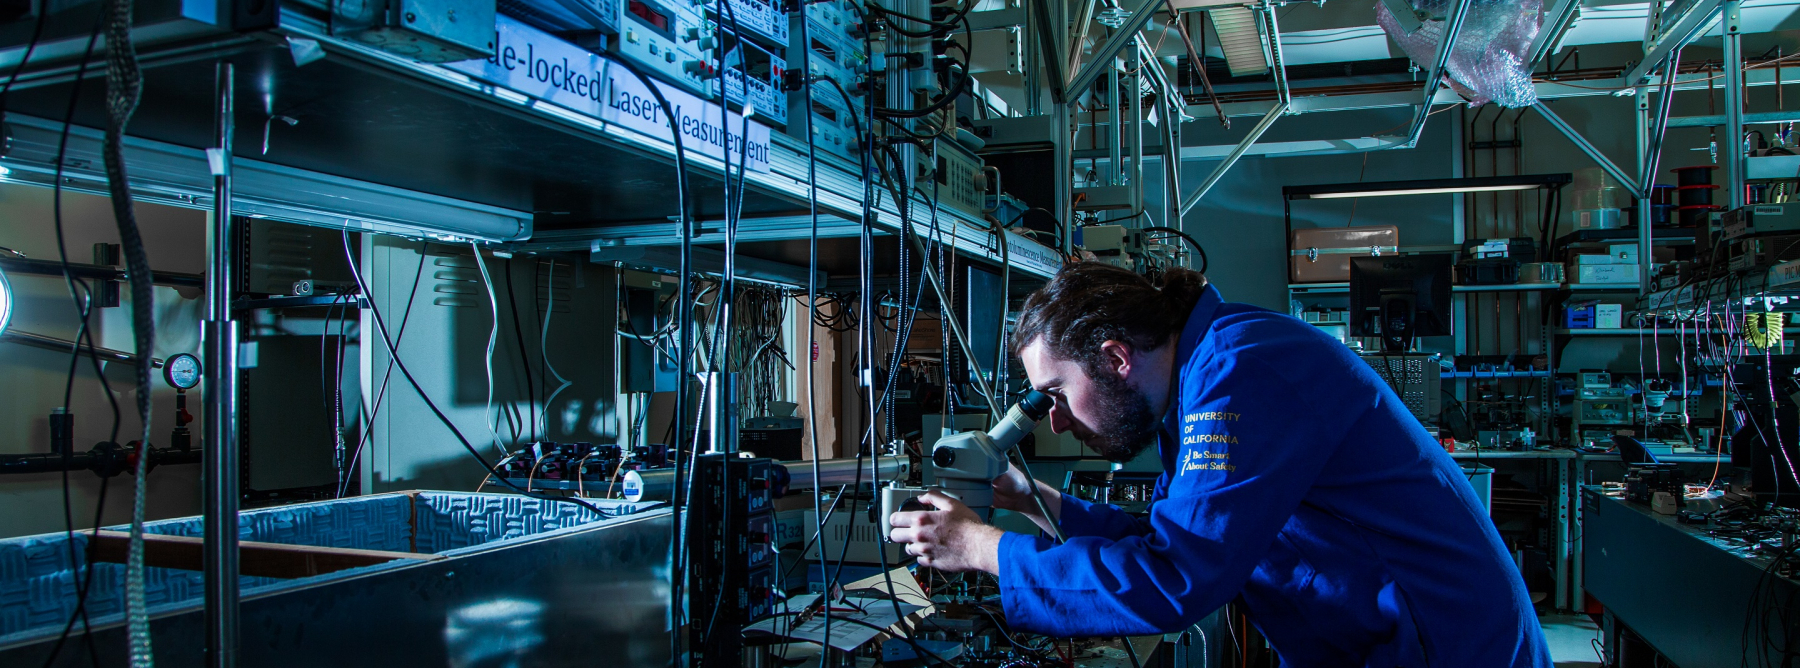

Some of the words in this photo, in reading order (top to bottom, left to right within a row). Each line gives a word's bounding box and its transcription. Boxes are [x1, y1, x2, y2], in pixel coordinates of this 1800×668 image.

[486, 31, 602, 104] de-locked
[608, 78, 662, 123] Laser
[1007, 240, 1039, 262] otoluminescence
[1785, 266, 1795, 280] PIC
[1184, 411, 1241, 424] UNIVERSITY
[1184, 424, 1195, 434] OF
[1183, 434, 1239, 445] CALIFORNIA
[1192, 450, 1203, 460] Be
[1203, 450, 1231, 460] Smart
[1186, 461, 1209, 471] About
[1209, 461, 1237, 473] Safety
